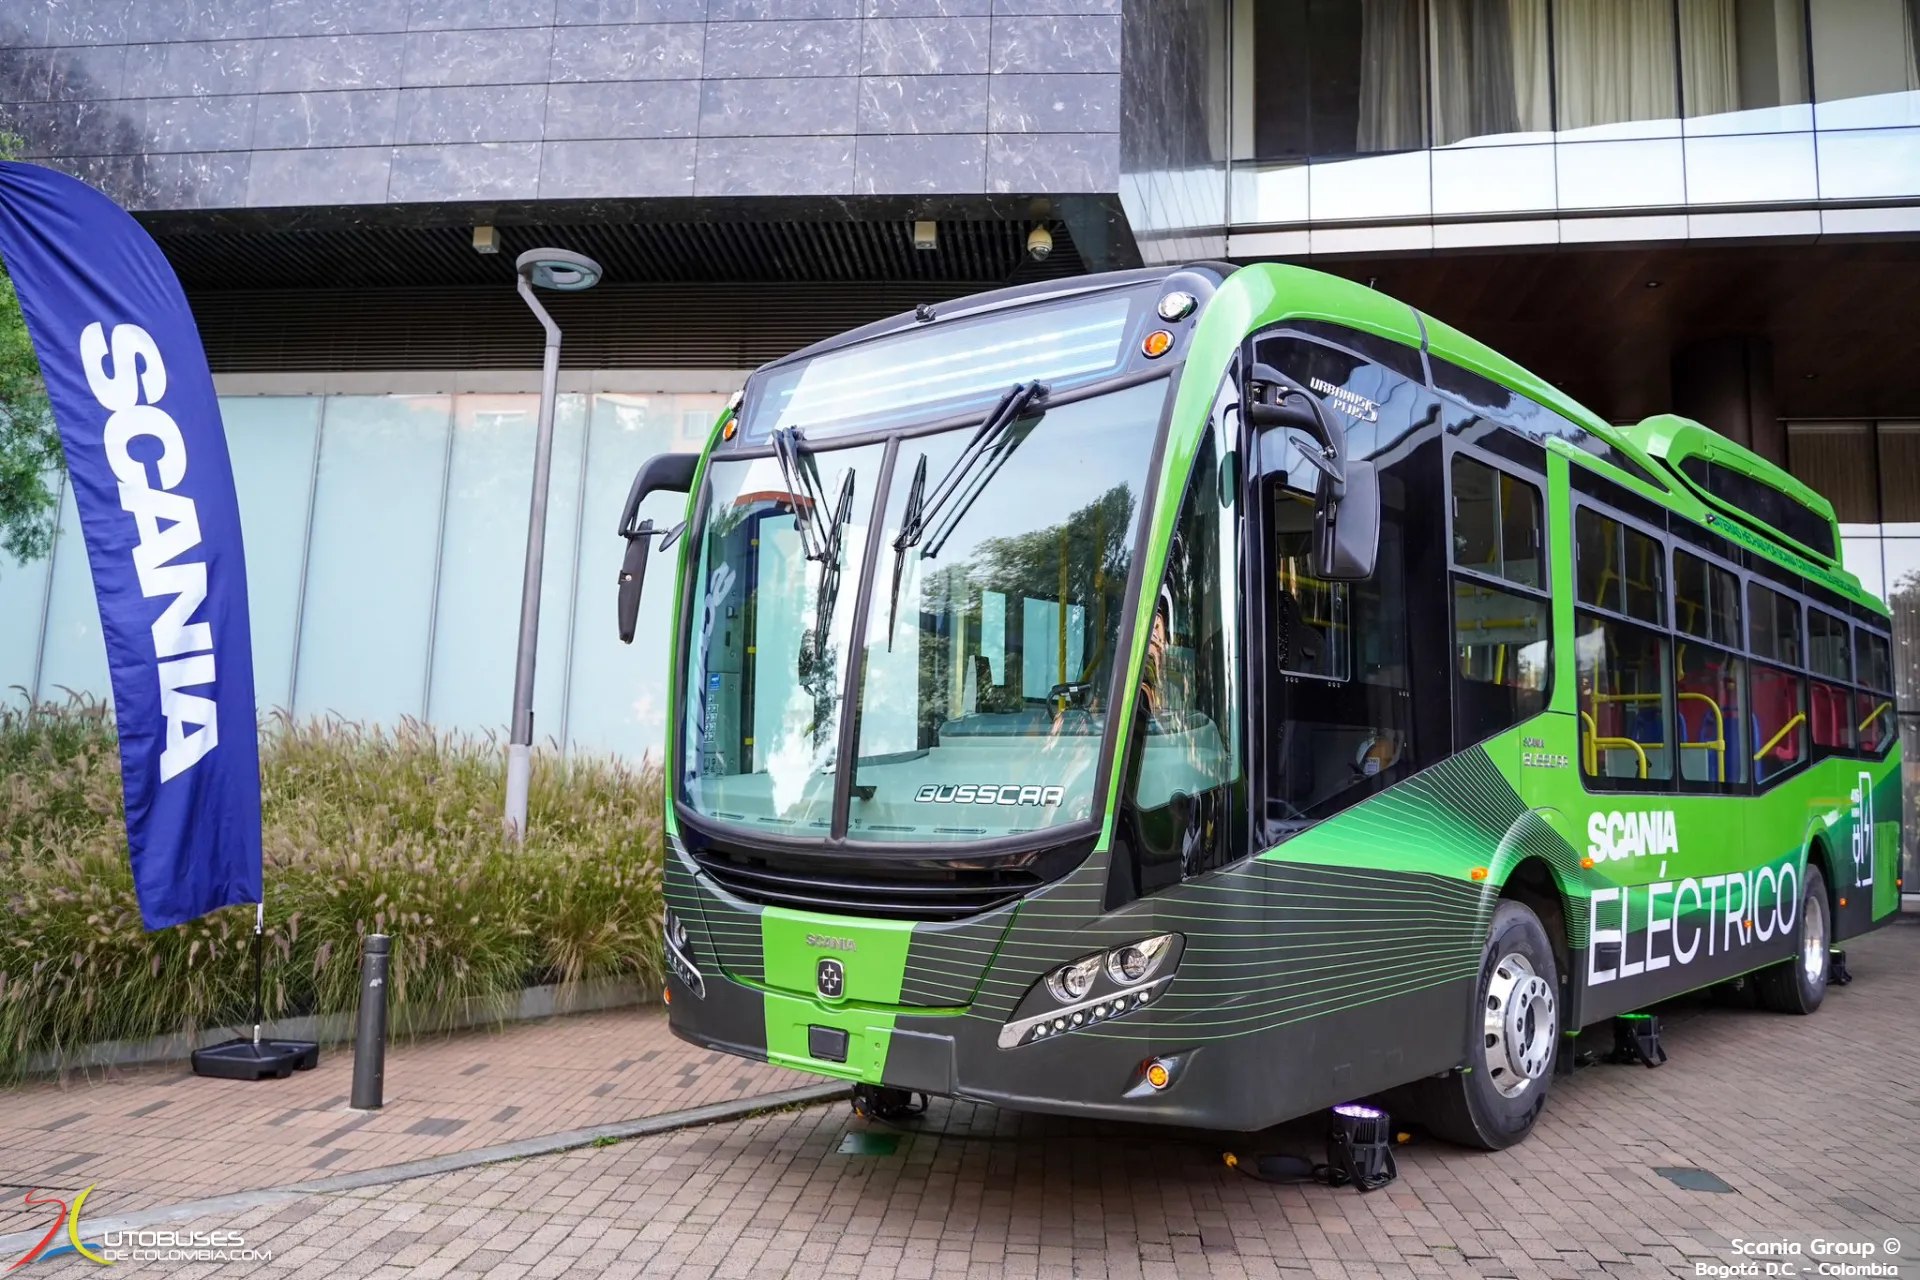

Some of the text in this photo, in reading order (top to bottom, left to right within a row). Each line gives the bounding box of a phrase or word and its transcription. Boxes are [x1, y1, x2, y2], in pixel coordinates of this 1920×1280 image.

[80, 321, 218, 784] SCANIA
[915, 784, 1065, 807] BUSSCAR
[1587, 810, 1679, 864] SCANIA
[806, 932, 857, 952] SCANIA
[1587, 860, 1798, 987] ELÉCTRICO
